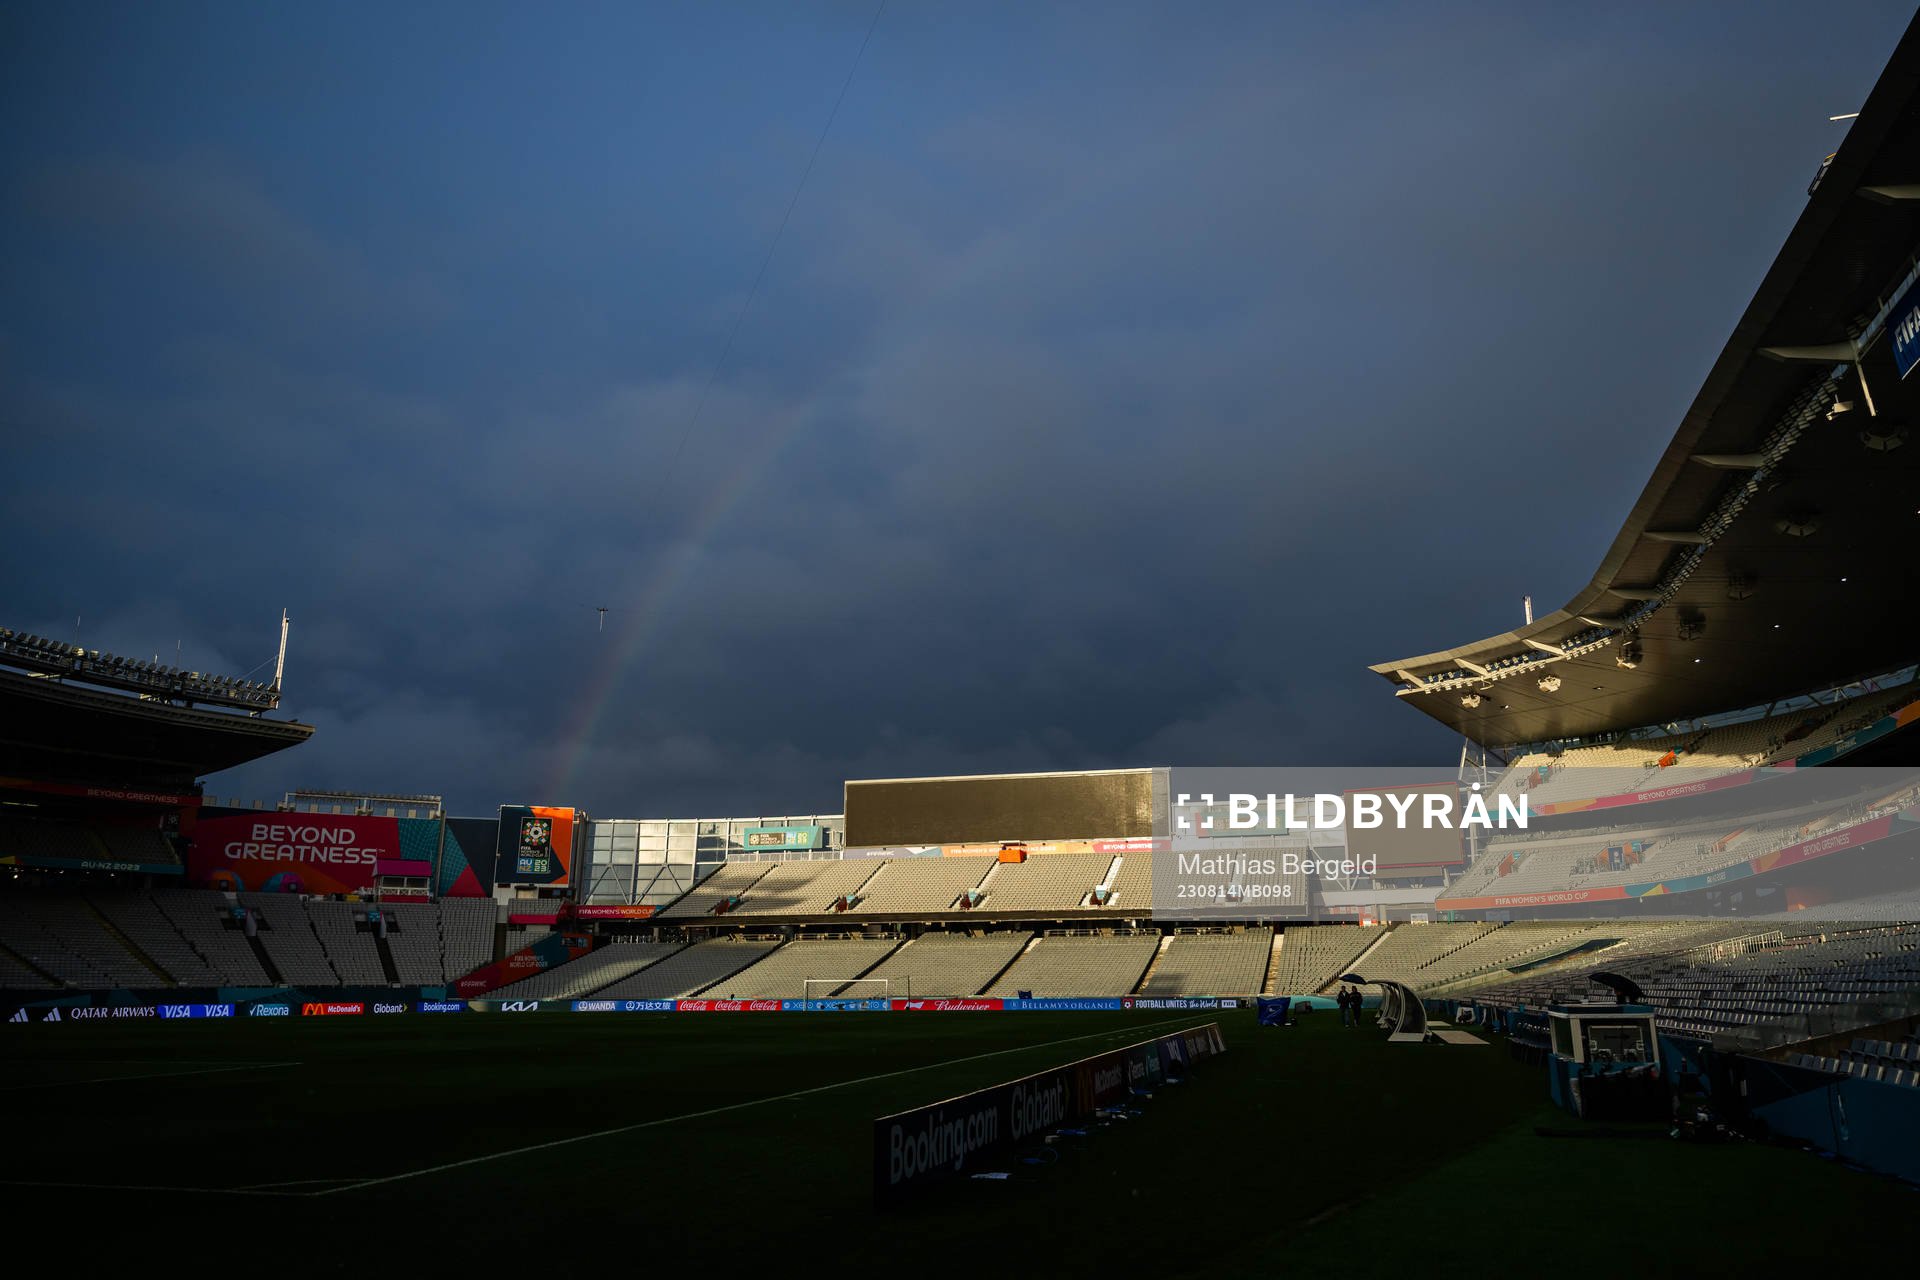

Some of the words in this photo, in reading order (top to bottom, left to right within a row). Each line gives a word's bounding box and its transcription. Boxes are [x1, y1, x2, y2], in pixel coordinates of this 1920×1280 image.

[87, 788, 125, 799] BEYOND
[126, 792, 178, 804] GREATNESS
[1637, 790, 1666, 801] BEYOND
[251, 823, 356, 844] BEYOND
[1512, 895, 1546, 904] WOMEN'S
[1547, 893, 1573, 902] WORLD
[256, 1004, 289, 1016] Rexona
[327, 1005, 361, 1013] McDonald's
[373, 1003, 403, 1014] Globant
[423, 1002, 460, 1013] Booking.com
[588, 1001, 616, 1010] WANDA
[934, 1001, 990, 1011] Budweiser
[1135, 1000, 1166, 1009] FOOTBALL
[1166, 1000, 1188, 1009] UNITES
[71, 1007, 108, 1019] QATAR
[111, 1006, 155, 1018] AIRWAYS
[164, 1006, 191, 1018] VISA
[203, 1005, 229, 1017] VISA
[1010, 1077, 1065, 1140] Globant
[889, 1105, 998, 1185] Booking.com
